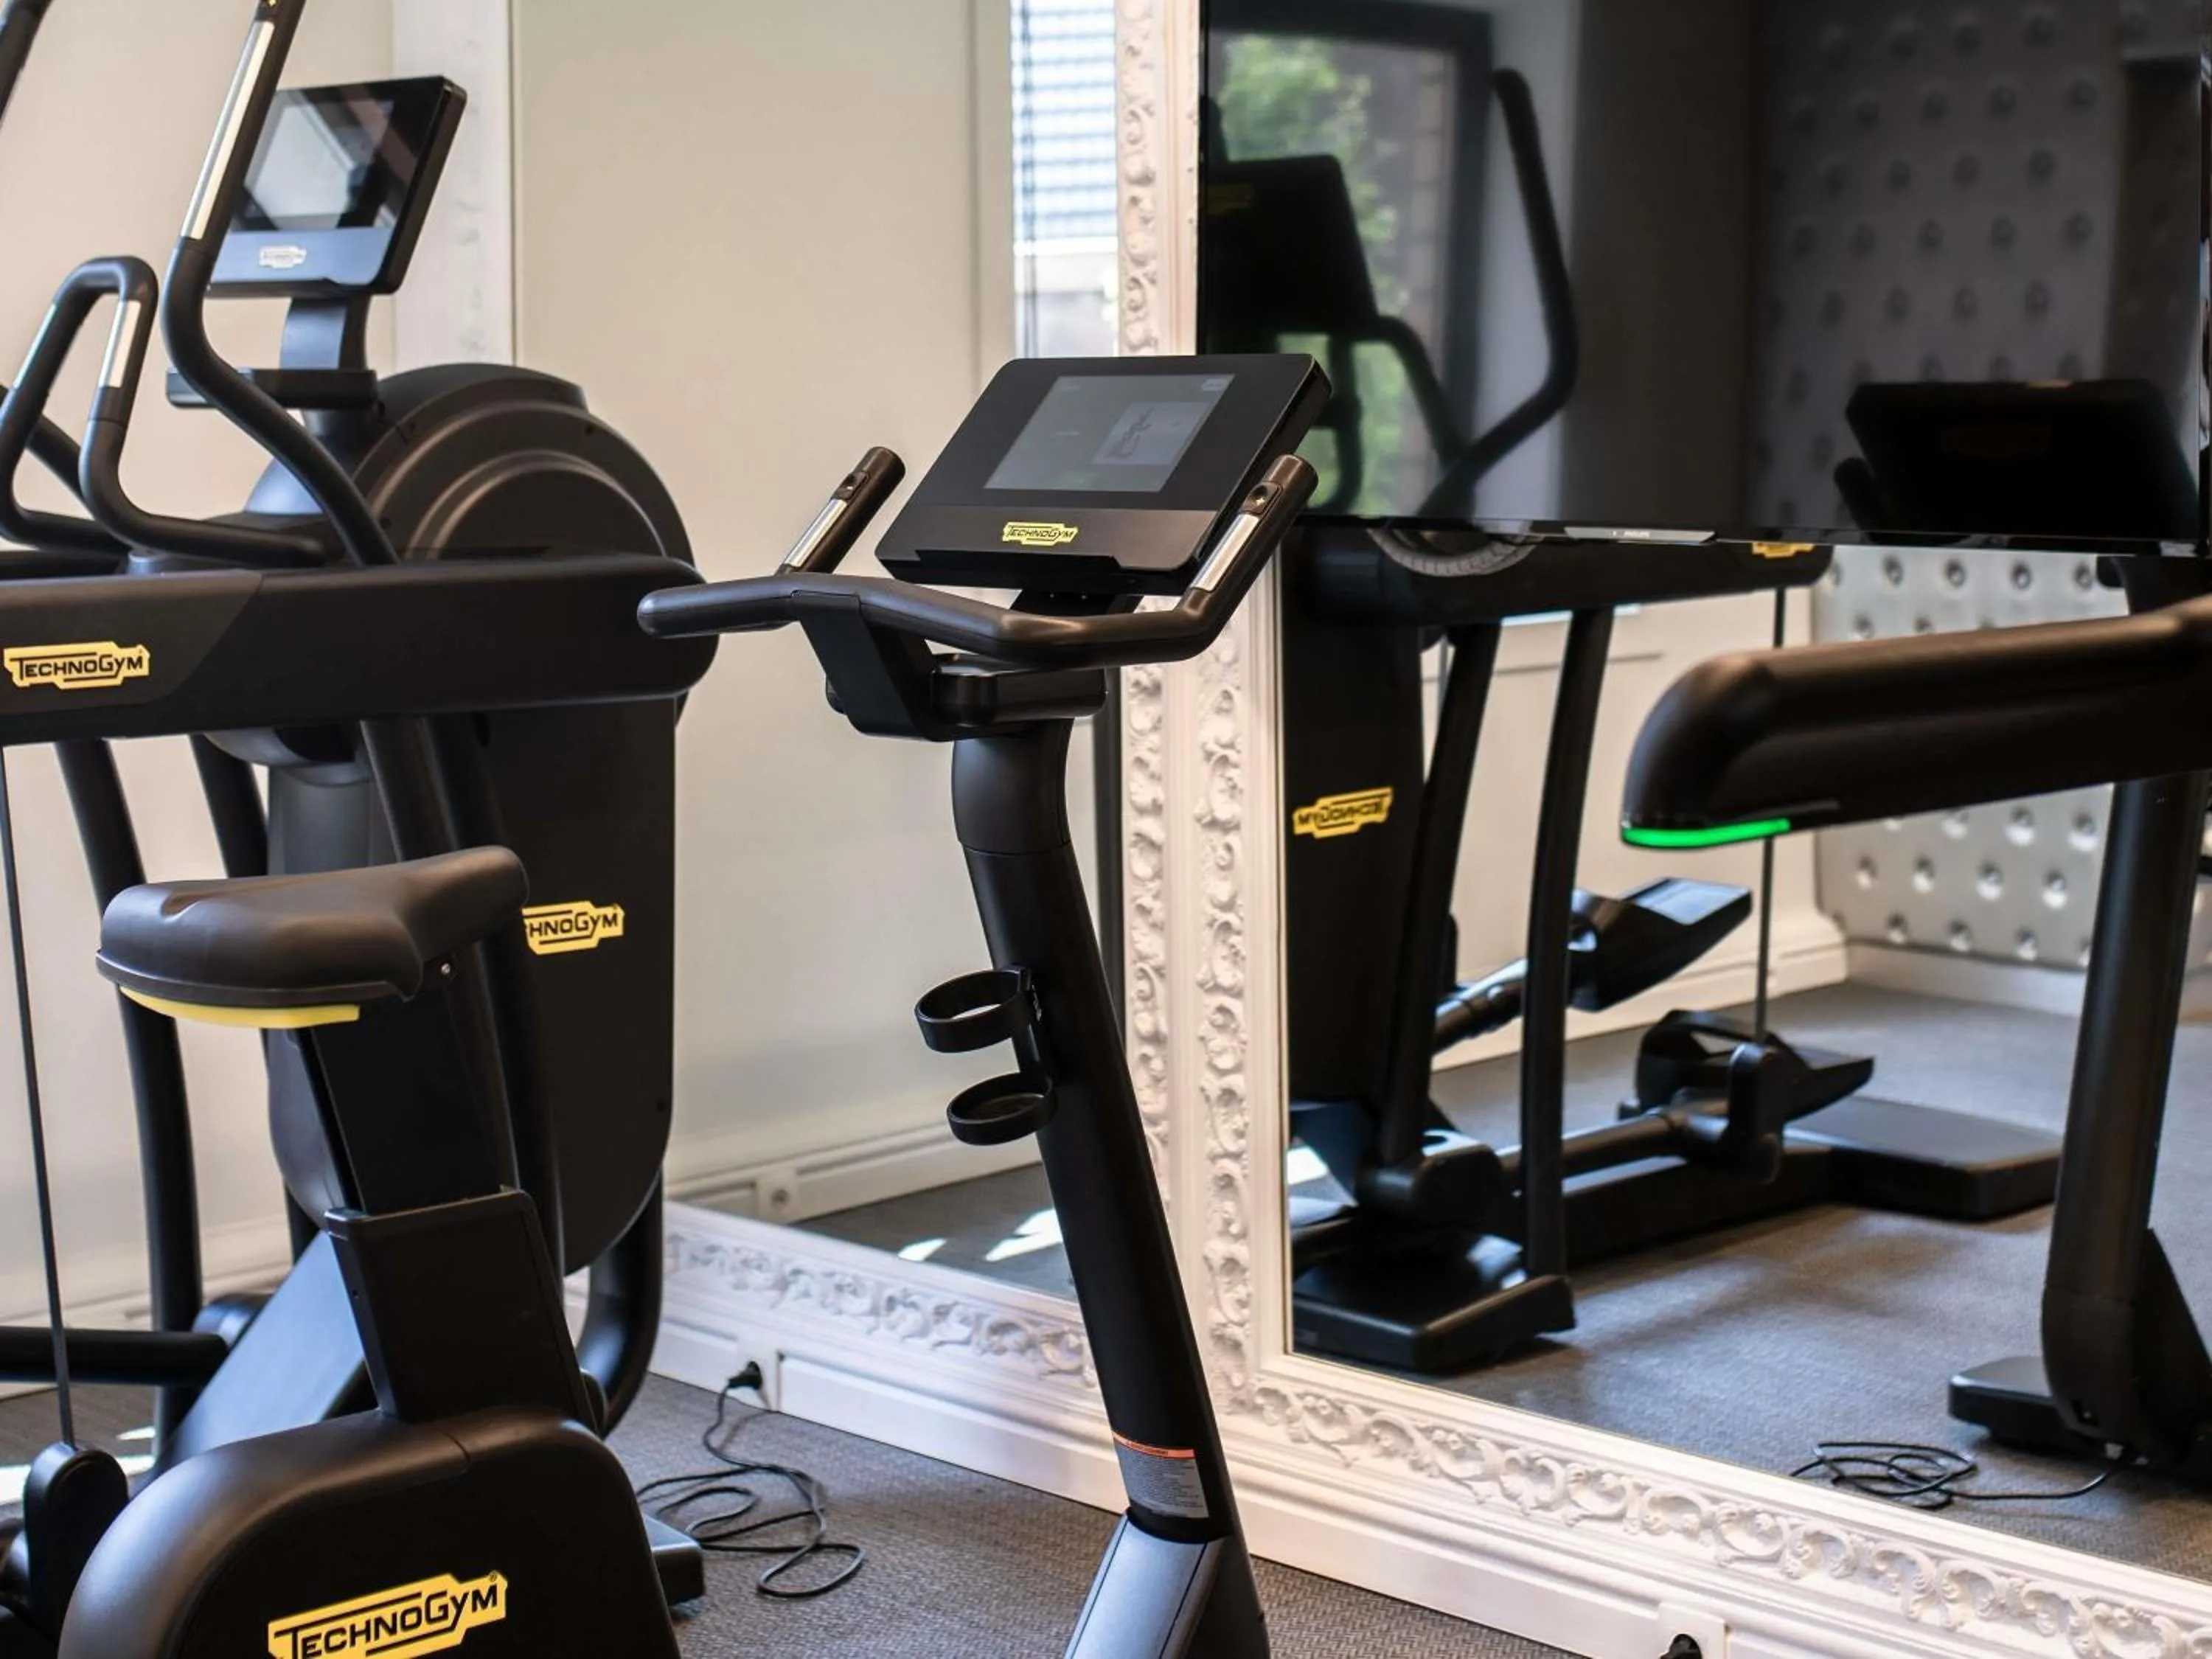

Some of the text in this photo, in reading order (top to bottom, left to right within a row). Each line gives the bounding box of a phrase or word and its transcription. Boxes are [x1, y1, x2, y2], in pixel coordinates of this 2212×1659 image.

[1007, 525, 1074, 541] TECHNOGYM
[10, 652, 143, 682] TECHNOGYM
[524, 911, 618, 939] HNOGYM
[274, 1584, 498, 1659] TECHNOGYM
